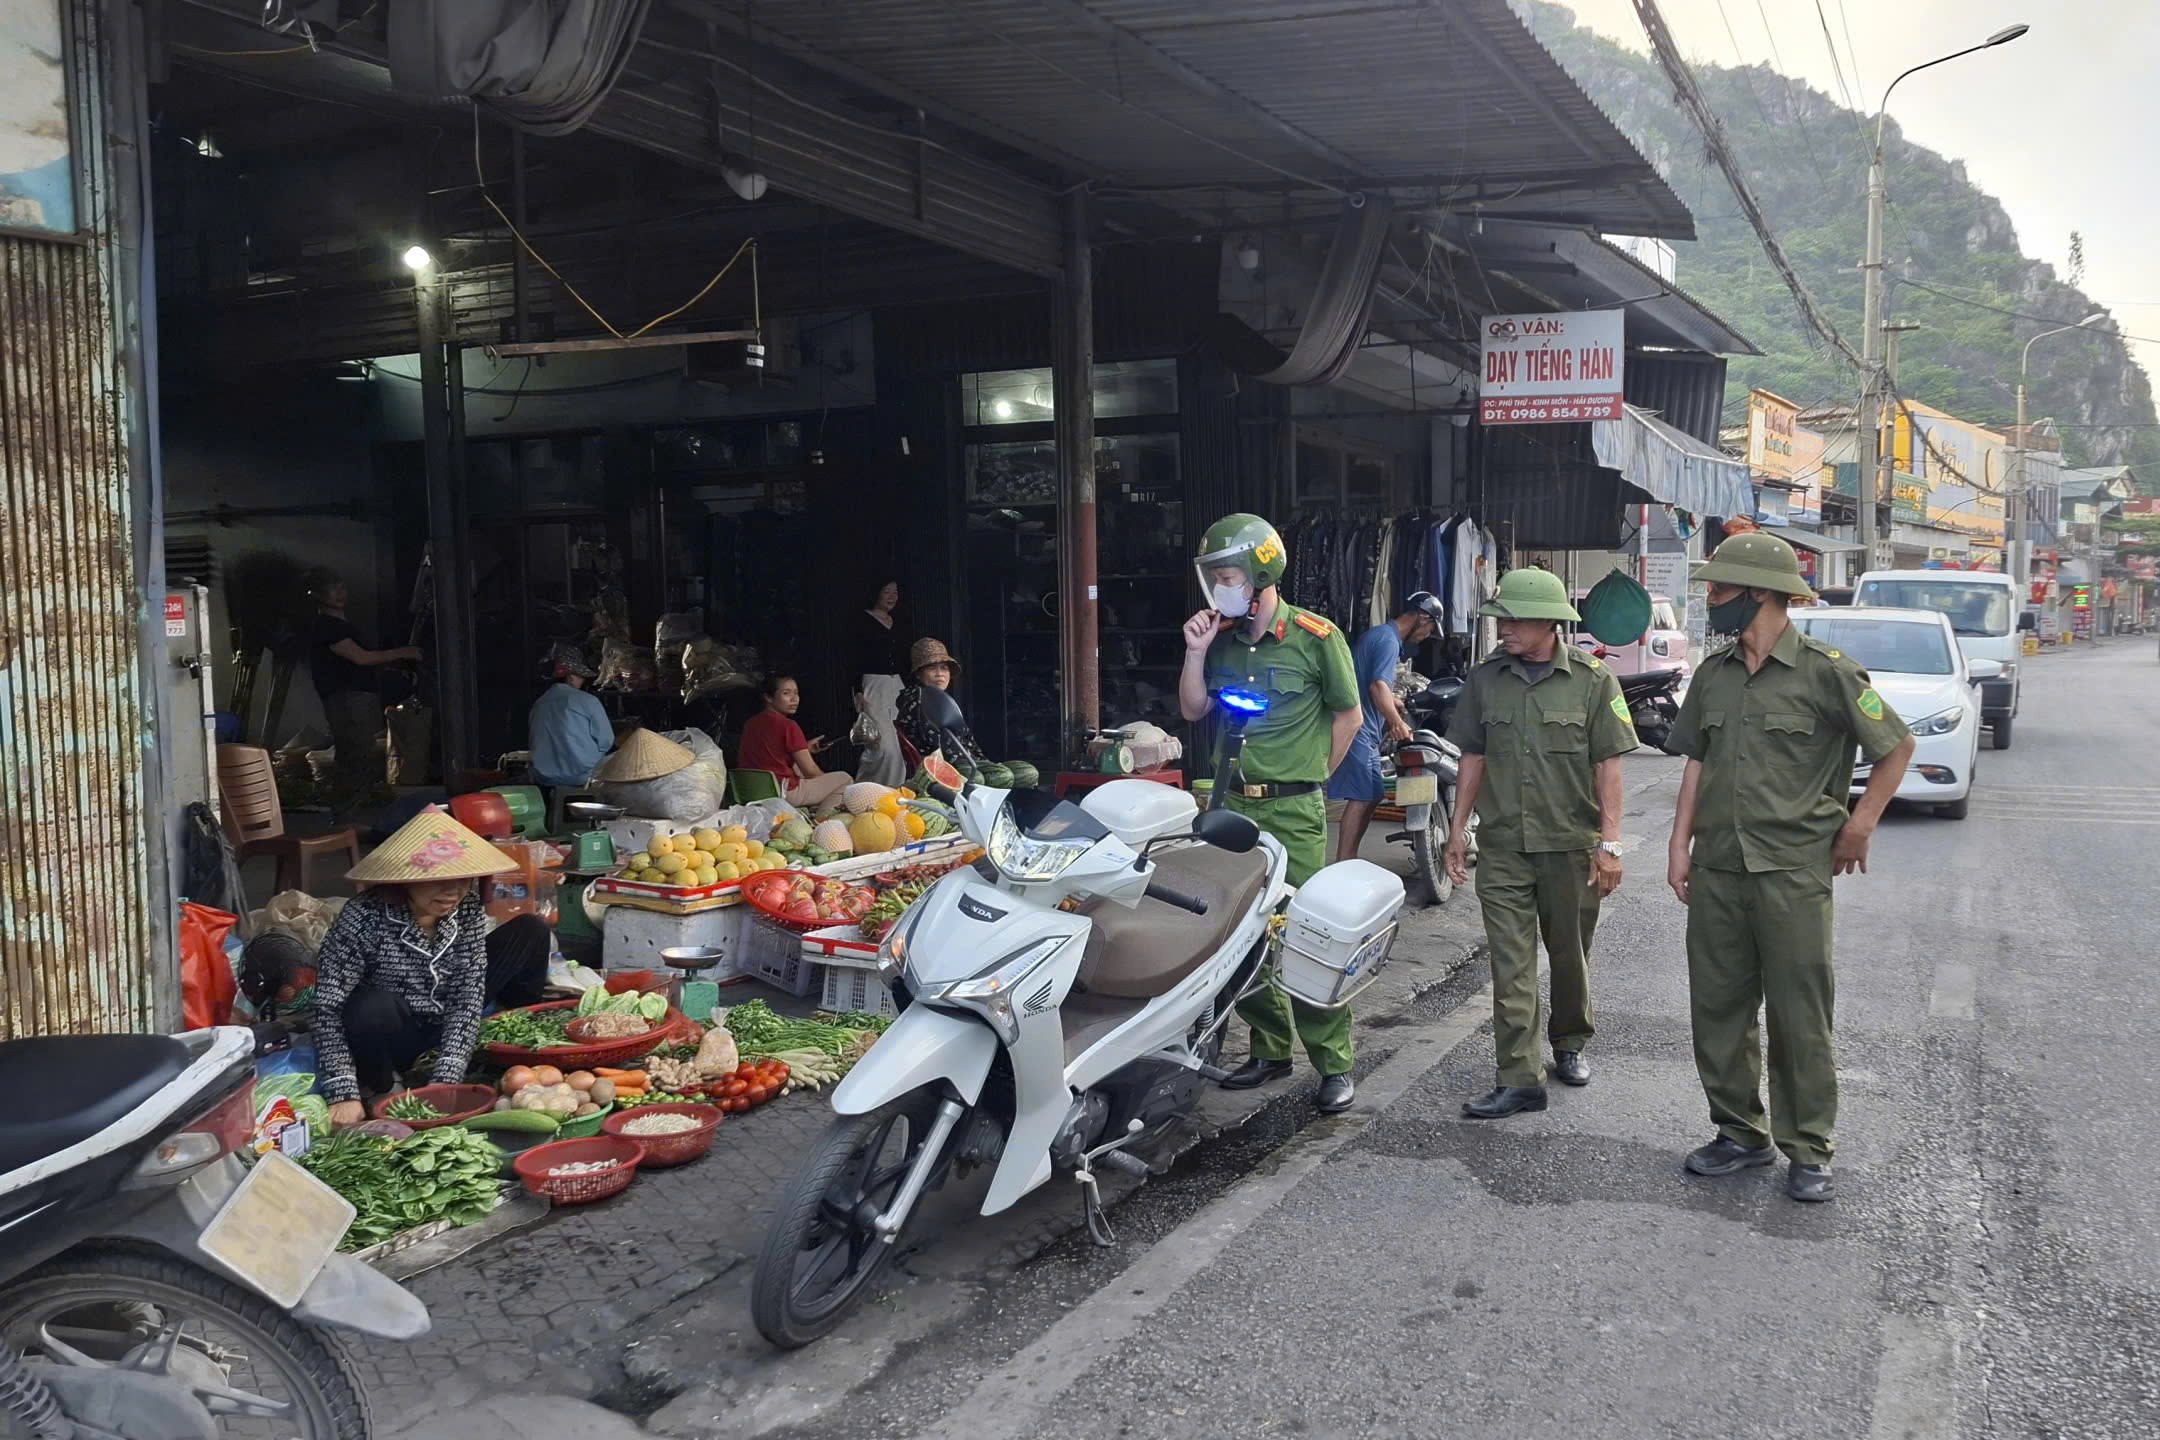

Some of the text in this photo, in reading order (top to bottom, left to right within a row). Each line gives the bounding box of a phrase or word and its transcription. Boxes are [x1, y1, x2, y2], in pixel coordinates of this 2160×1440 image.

[1522, 317, 1564, 334] VÂN:
[1487, 338, 1613, 390] DẠY TIẾNG HÀN
[1484, 406, 1612, 419] ĐT: 0986 854 789
[1023, 1004, 1057, 1019] HONDA
